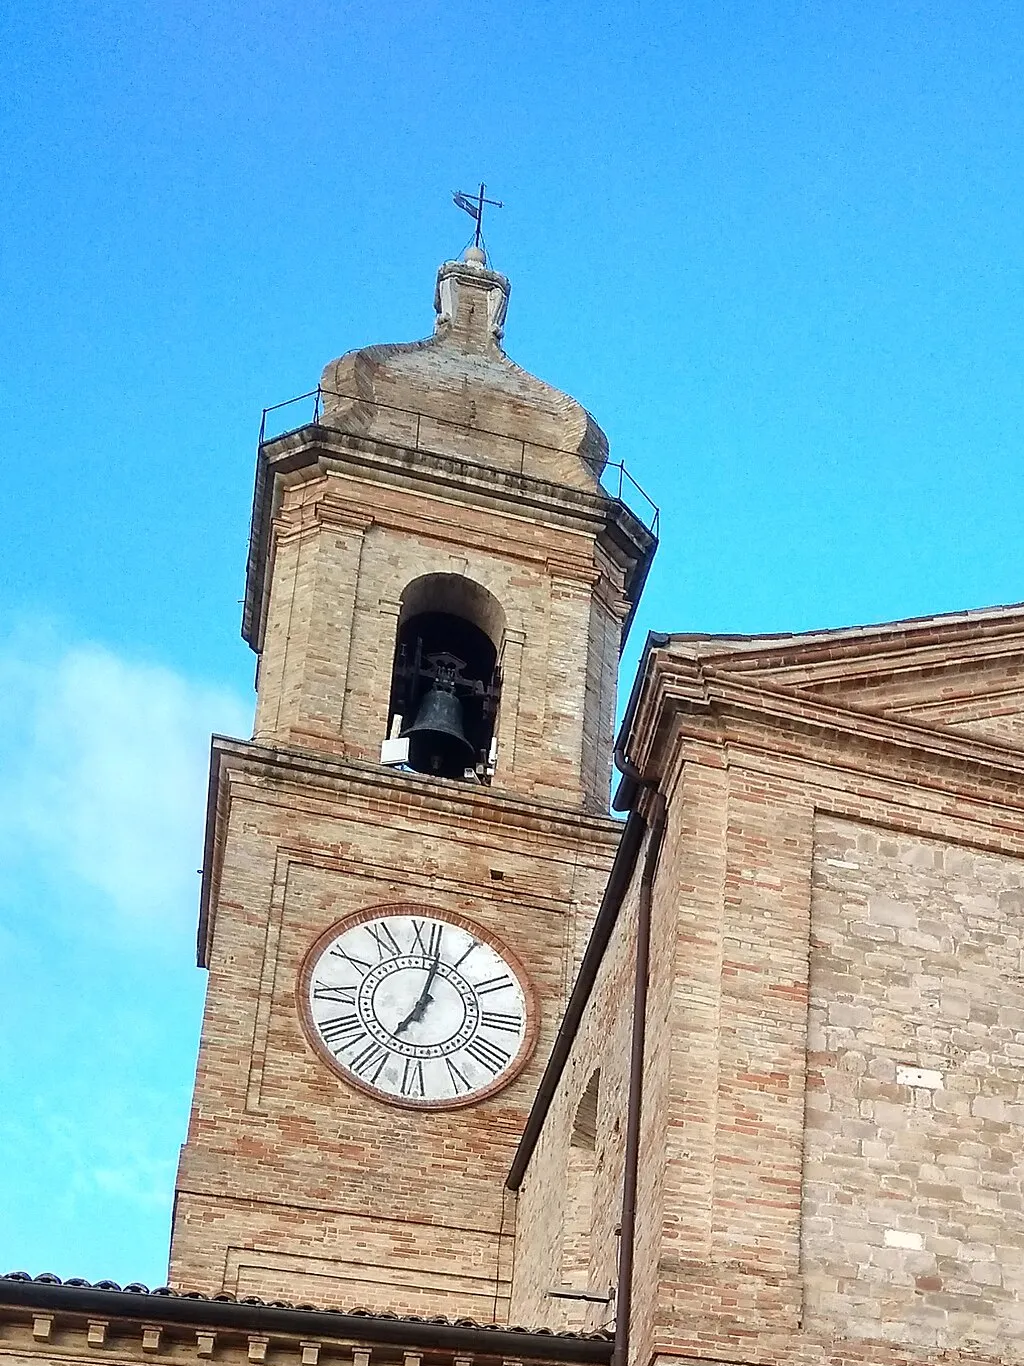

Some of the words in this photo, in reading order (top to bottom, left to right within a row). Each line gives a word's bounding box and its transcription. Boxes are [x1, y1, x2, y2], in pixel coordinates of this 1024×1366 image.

[363, 921, 403, 960] XI
[410, 919, 443, 957] XII
[452, 940, 482, 969] I
[330, 943, 372, 977] X
[313, 980, 358, 1006] IX
[473, 974, 514, 996] II
[317, 1012, 368, 1056] VIII
[481, 1011, 523, 1035] III
[348, 1040, 391, 1085] VII
[465, 1034, 512, 1076] IIII
[400, 1057, 426, 1097] VI
[444, 1057, 473, 1095] V
